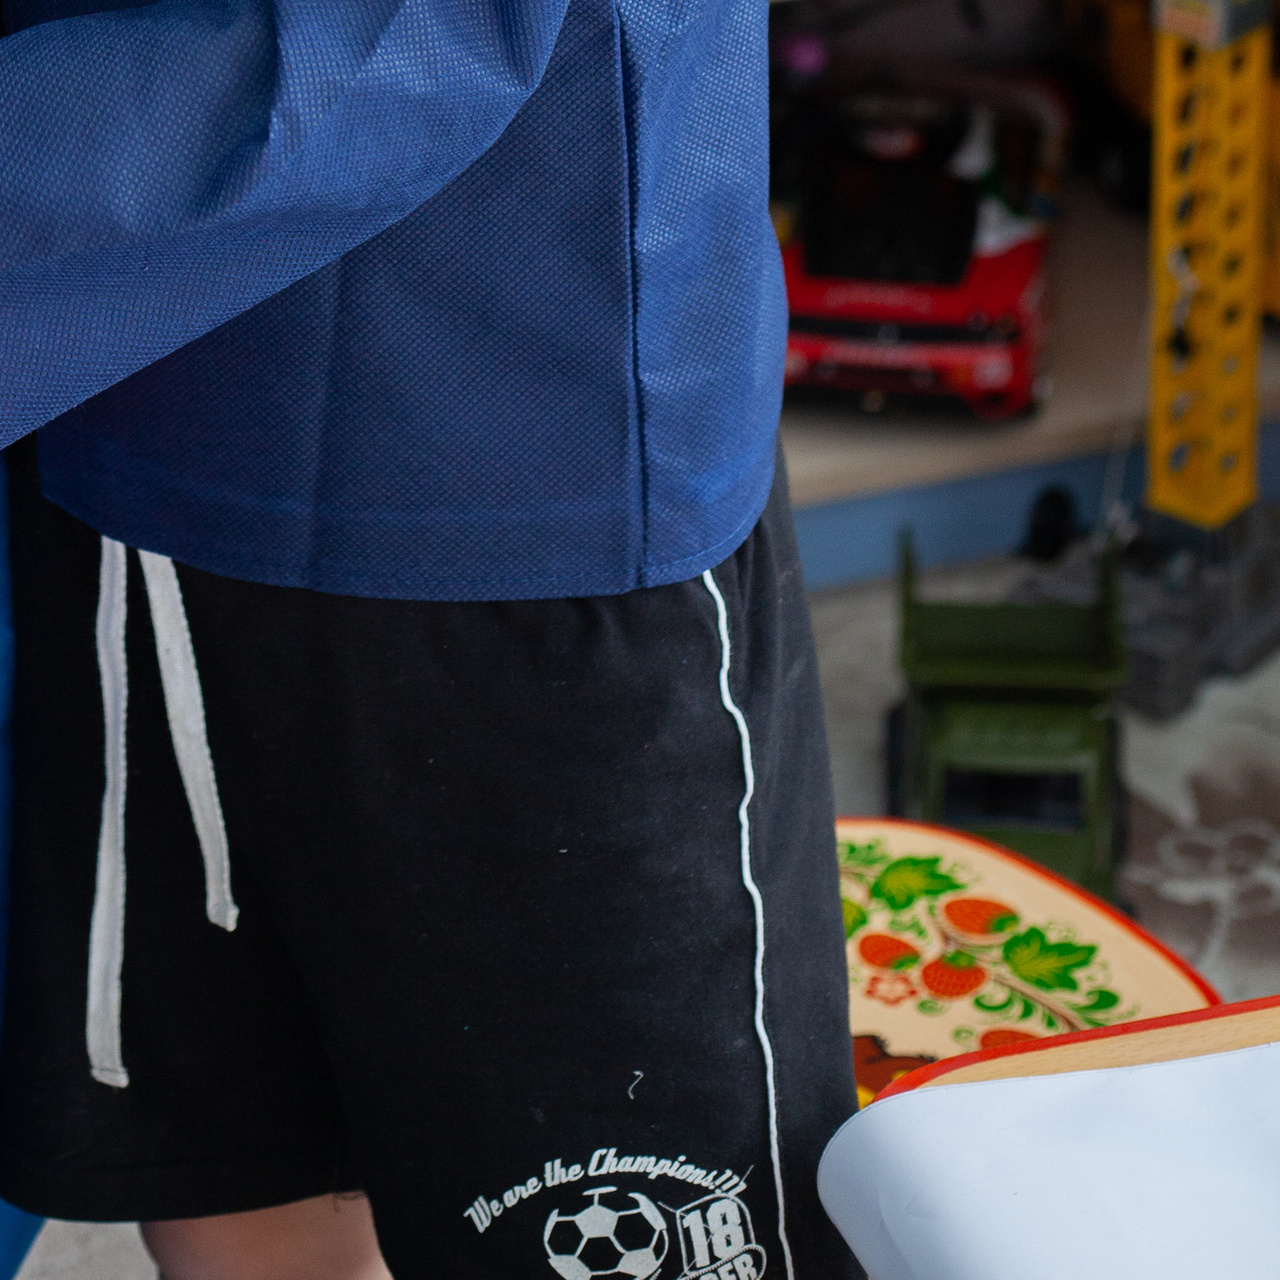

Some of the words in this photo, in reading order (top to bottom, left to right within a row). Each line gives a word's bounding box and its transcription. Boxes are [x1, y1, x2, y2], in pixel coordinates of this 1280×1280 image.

[463, 1195, 503, 1234] We
[502, 1176, 542, 1208] are
[542, 1157, 585, 1188] the
[682, 1198, 746, 1268] 18
